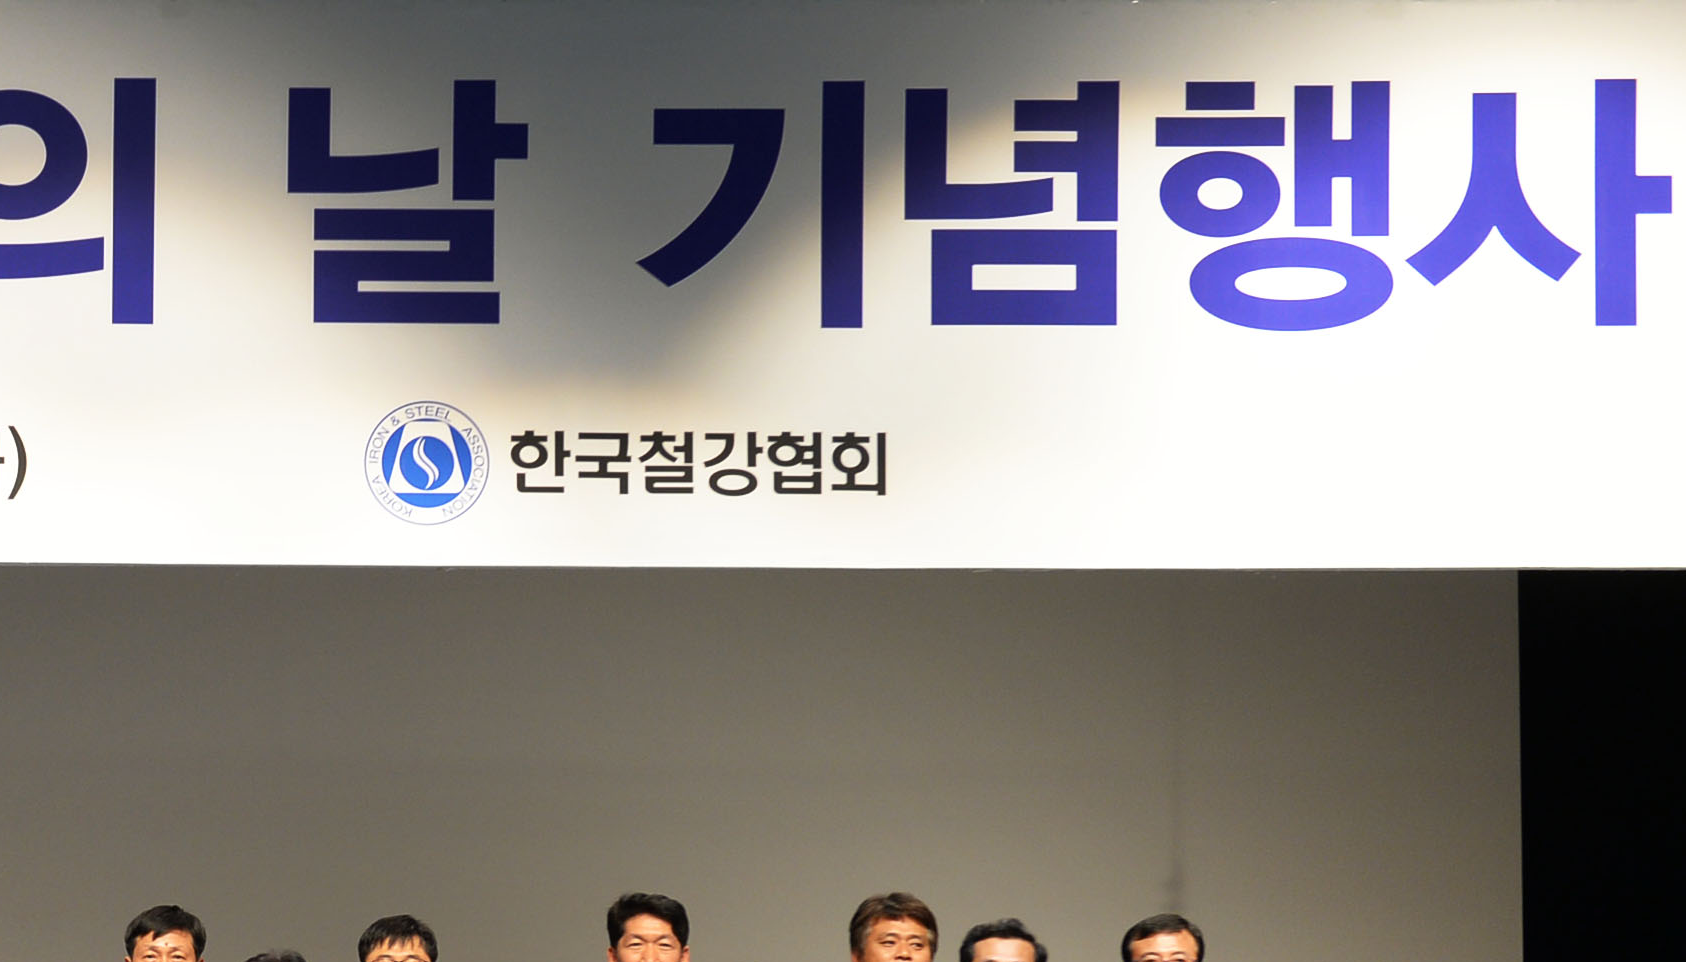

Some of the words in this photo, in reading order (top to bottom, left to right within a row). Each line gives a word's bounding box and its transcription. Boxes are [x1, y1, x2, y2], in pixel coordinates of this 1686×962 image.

[288, 80, 528, 324] 날
[637, 78, 1673, 331] 기념행사
[404, 405, 452, 422] STEEL
[369, 426, 390, 465] IRON
[442, 426, 486, 518] ASSOCIATION
[510, 430, 887, 498] 한국철강협회
[371, 475, 413, 518] KOREA
